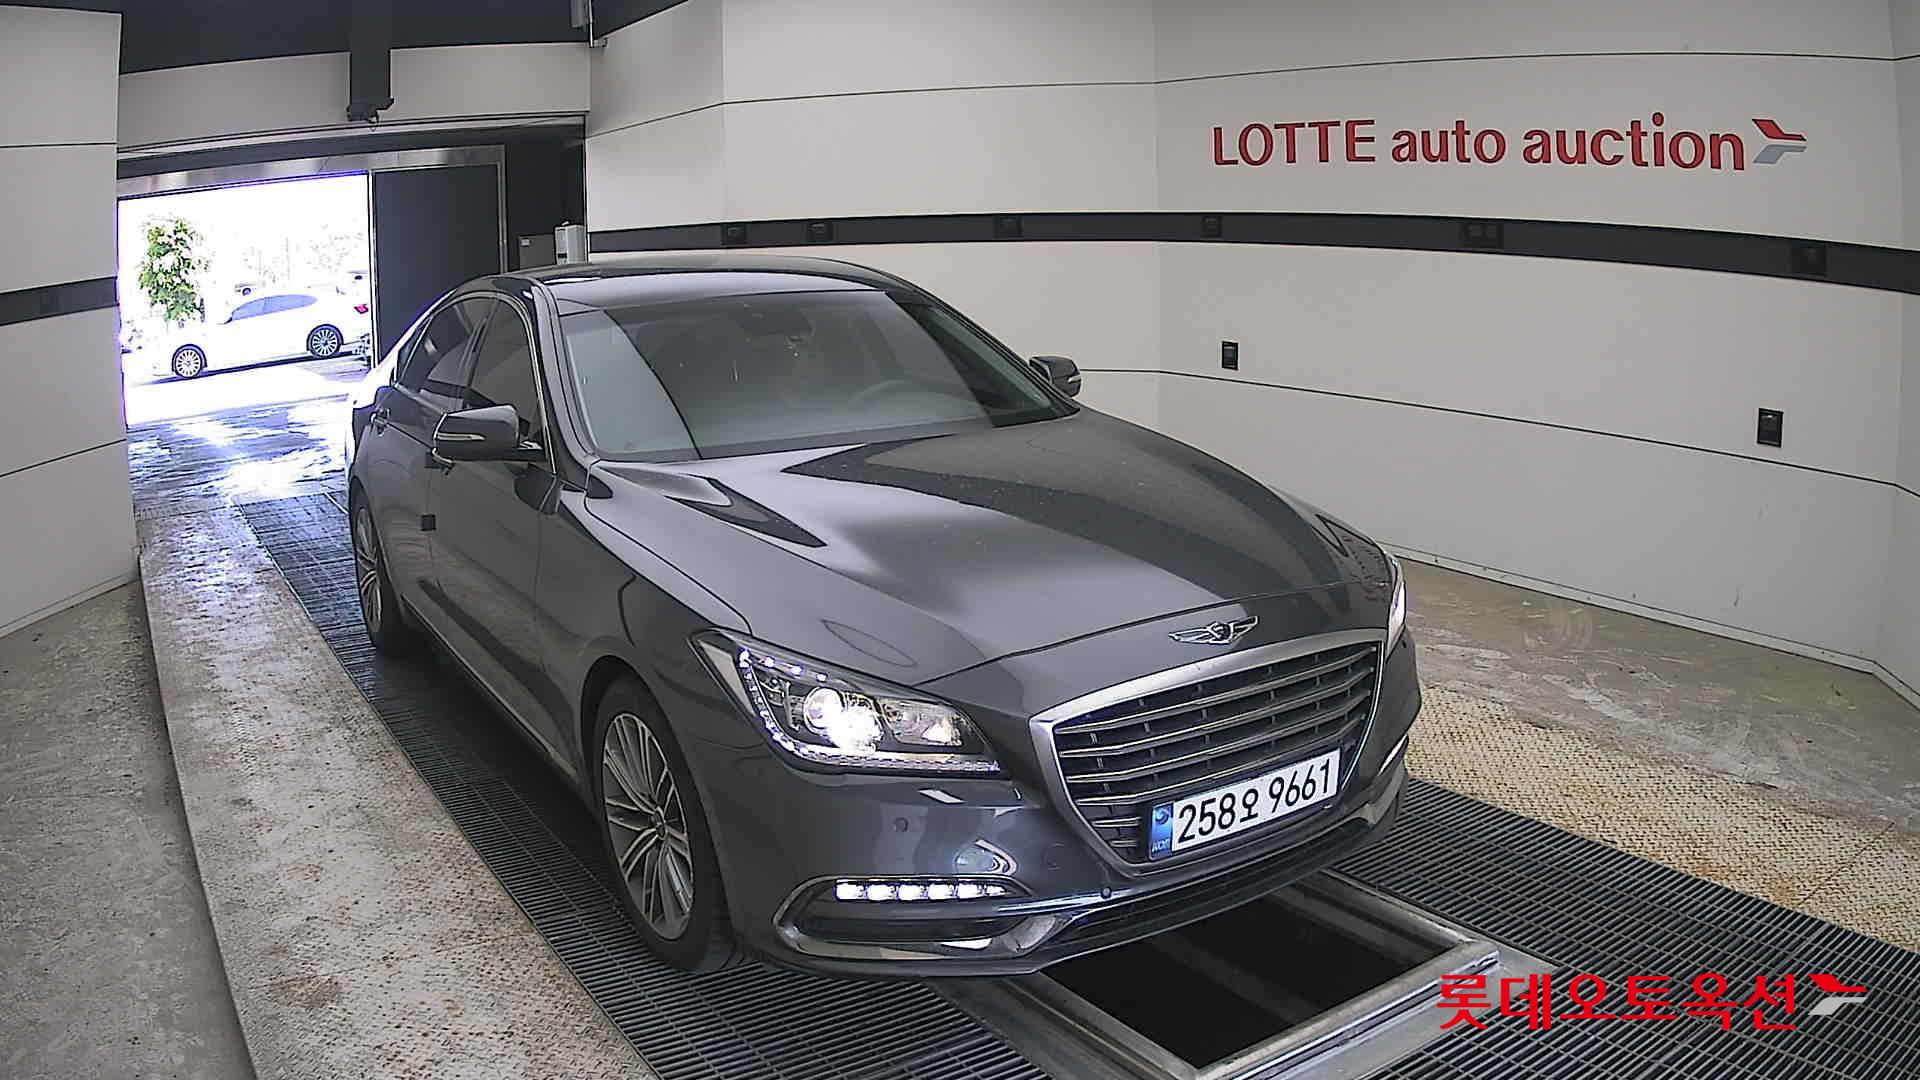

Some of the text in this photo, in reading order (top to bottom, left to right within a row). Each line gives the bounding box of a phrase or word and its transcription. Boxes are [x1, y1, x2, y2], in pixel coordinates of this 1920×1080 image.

[1213, 112, 1745, 171] LOTTE auto auction
[1177, 758, 1330, 844] 258오 9661
